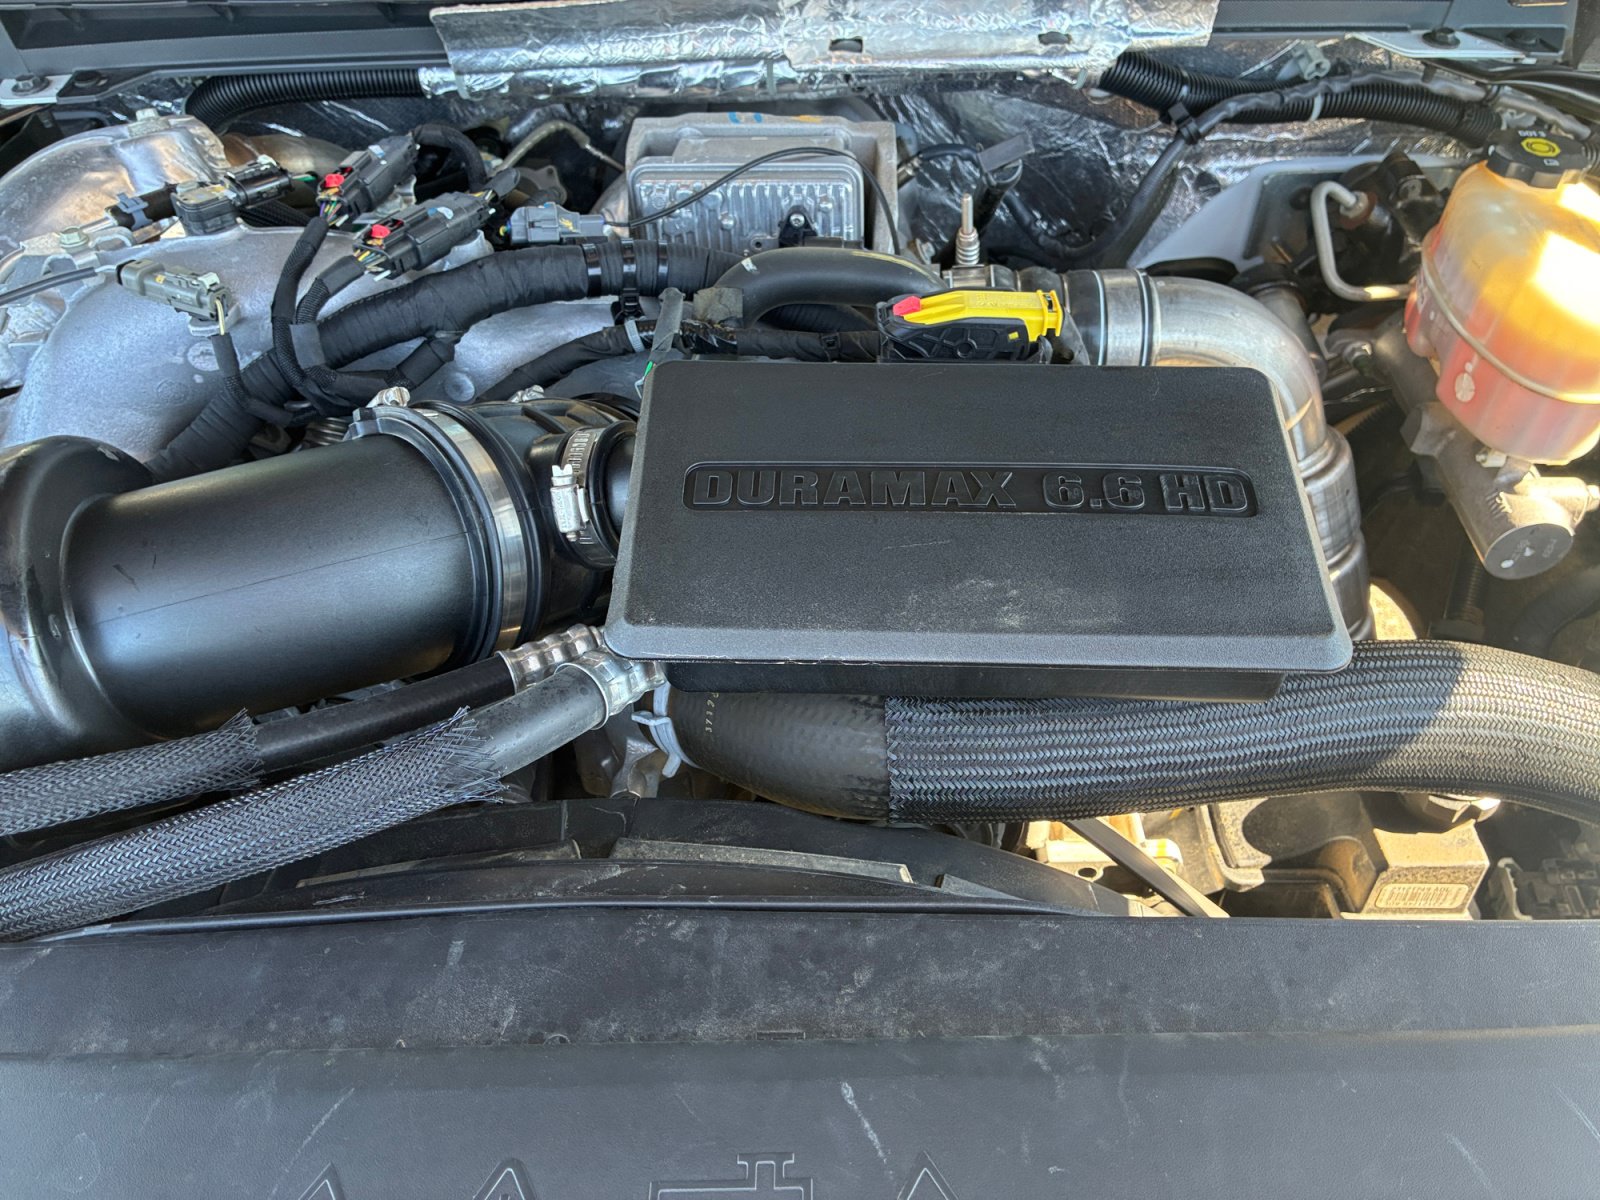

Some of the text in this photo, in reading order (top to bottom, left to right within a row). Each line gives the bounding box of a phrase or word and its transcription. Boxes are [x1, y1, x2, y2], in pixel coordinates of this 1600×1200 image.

[692, 470, 1249, 512] DURAMAX 6.6 HD
